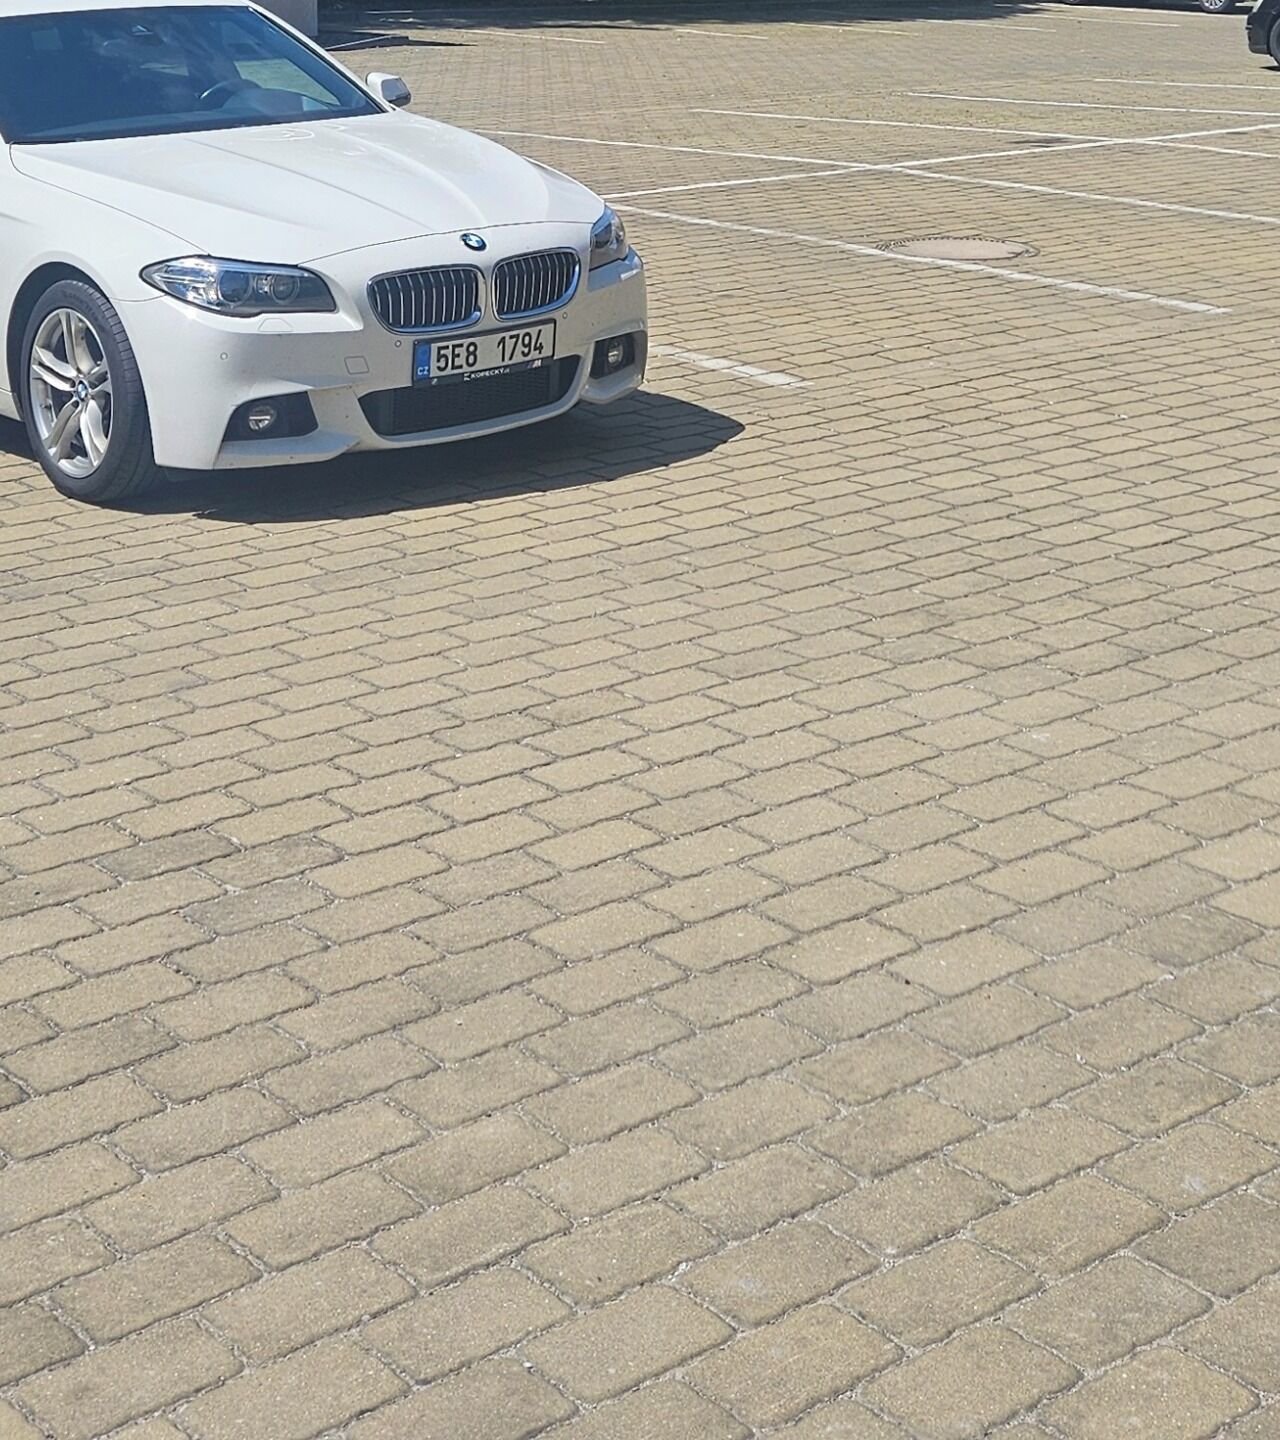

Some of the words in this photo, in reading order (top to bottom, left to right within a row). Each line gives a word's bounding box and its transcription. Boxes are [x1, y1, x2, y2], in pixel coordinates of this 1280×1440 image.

[436, 341, 478, 372] 5E8
[497, 328, 544, 363] 1794
[417, 366, 429, 376] CZ
